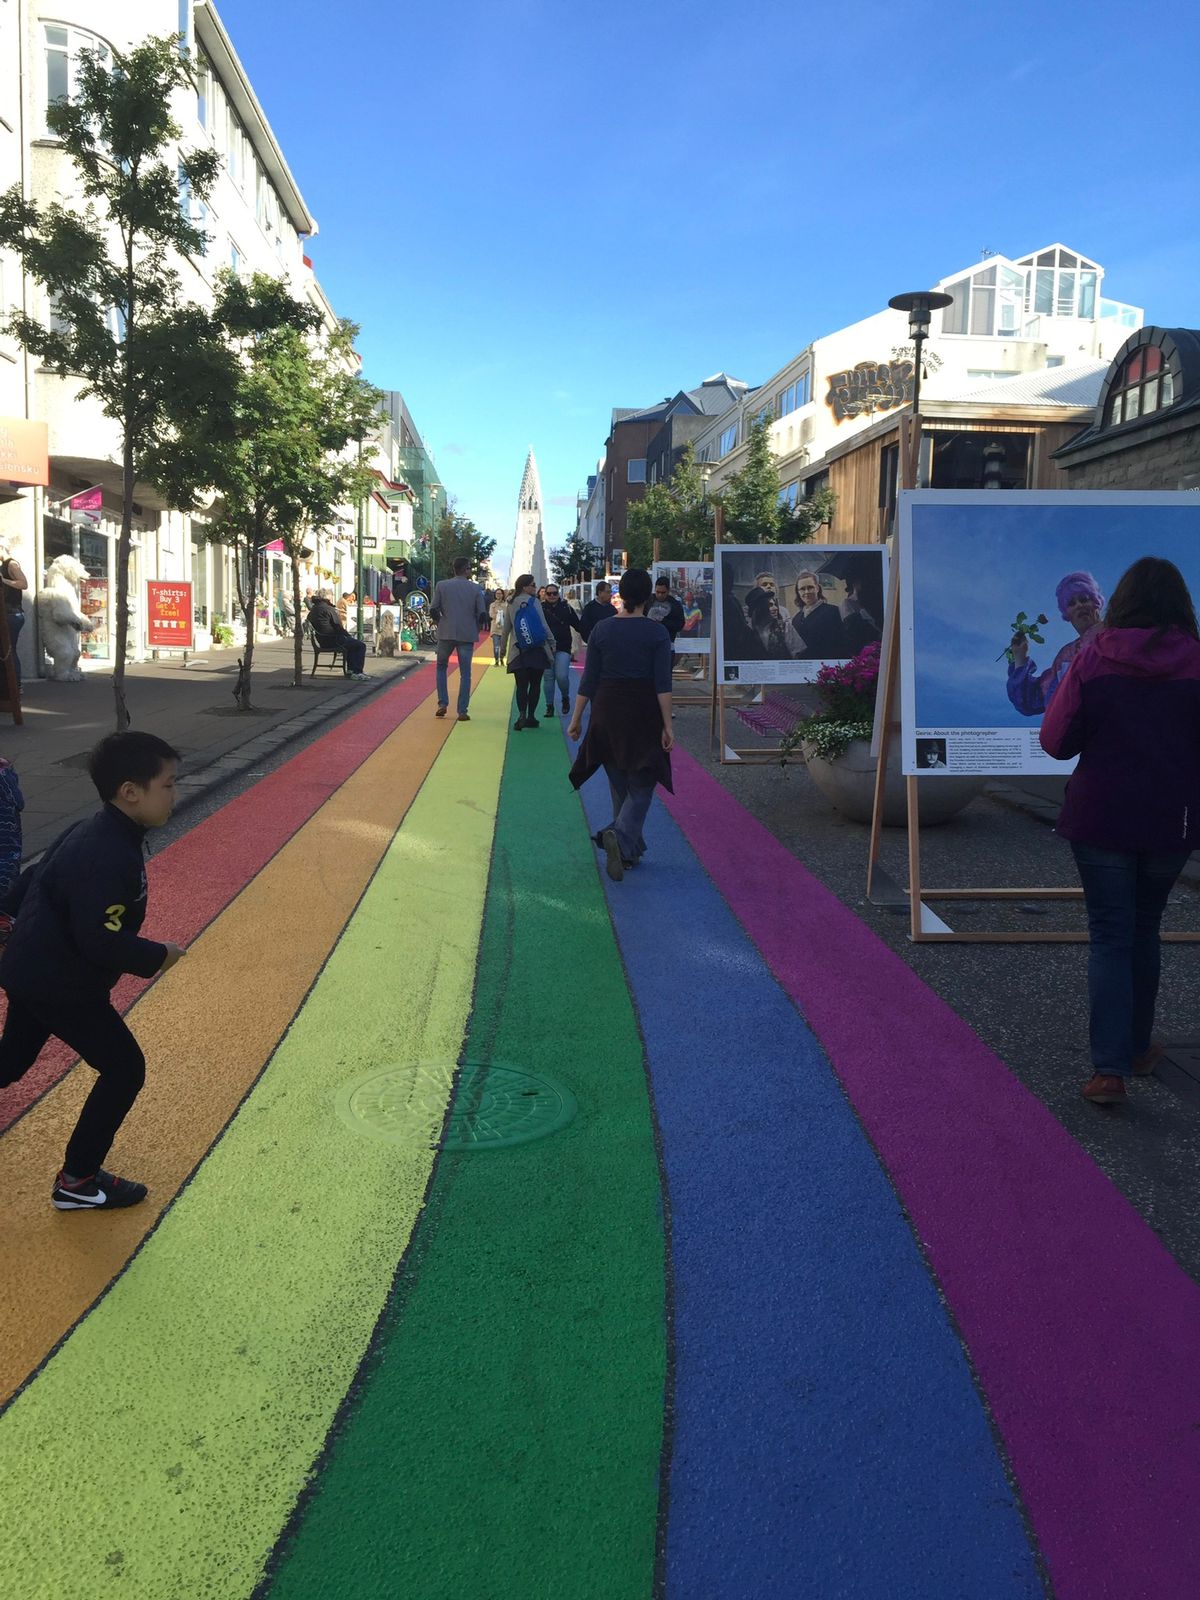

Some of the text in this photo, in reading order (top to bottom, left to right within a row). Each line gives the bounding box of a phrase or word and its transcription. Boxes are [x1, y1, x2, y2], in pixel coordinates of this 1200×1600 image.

[152, 588, 187, 597] T-shirts:
[160, 595, 172, 604] Buy
[520, 618, 531, 645] adidas
[103, 904, 126, 932] 3
